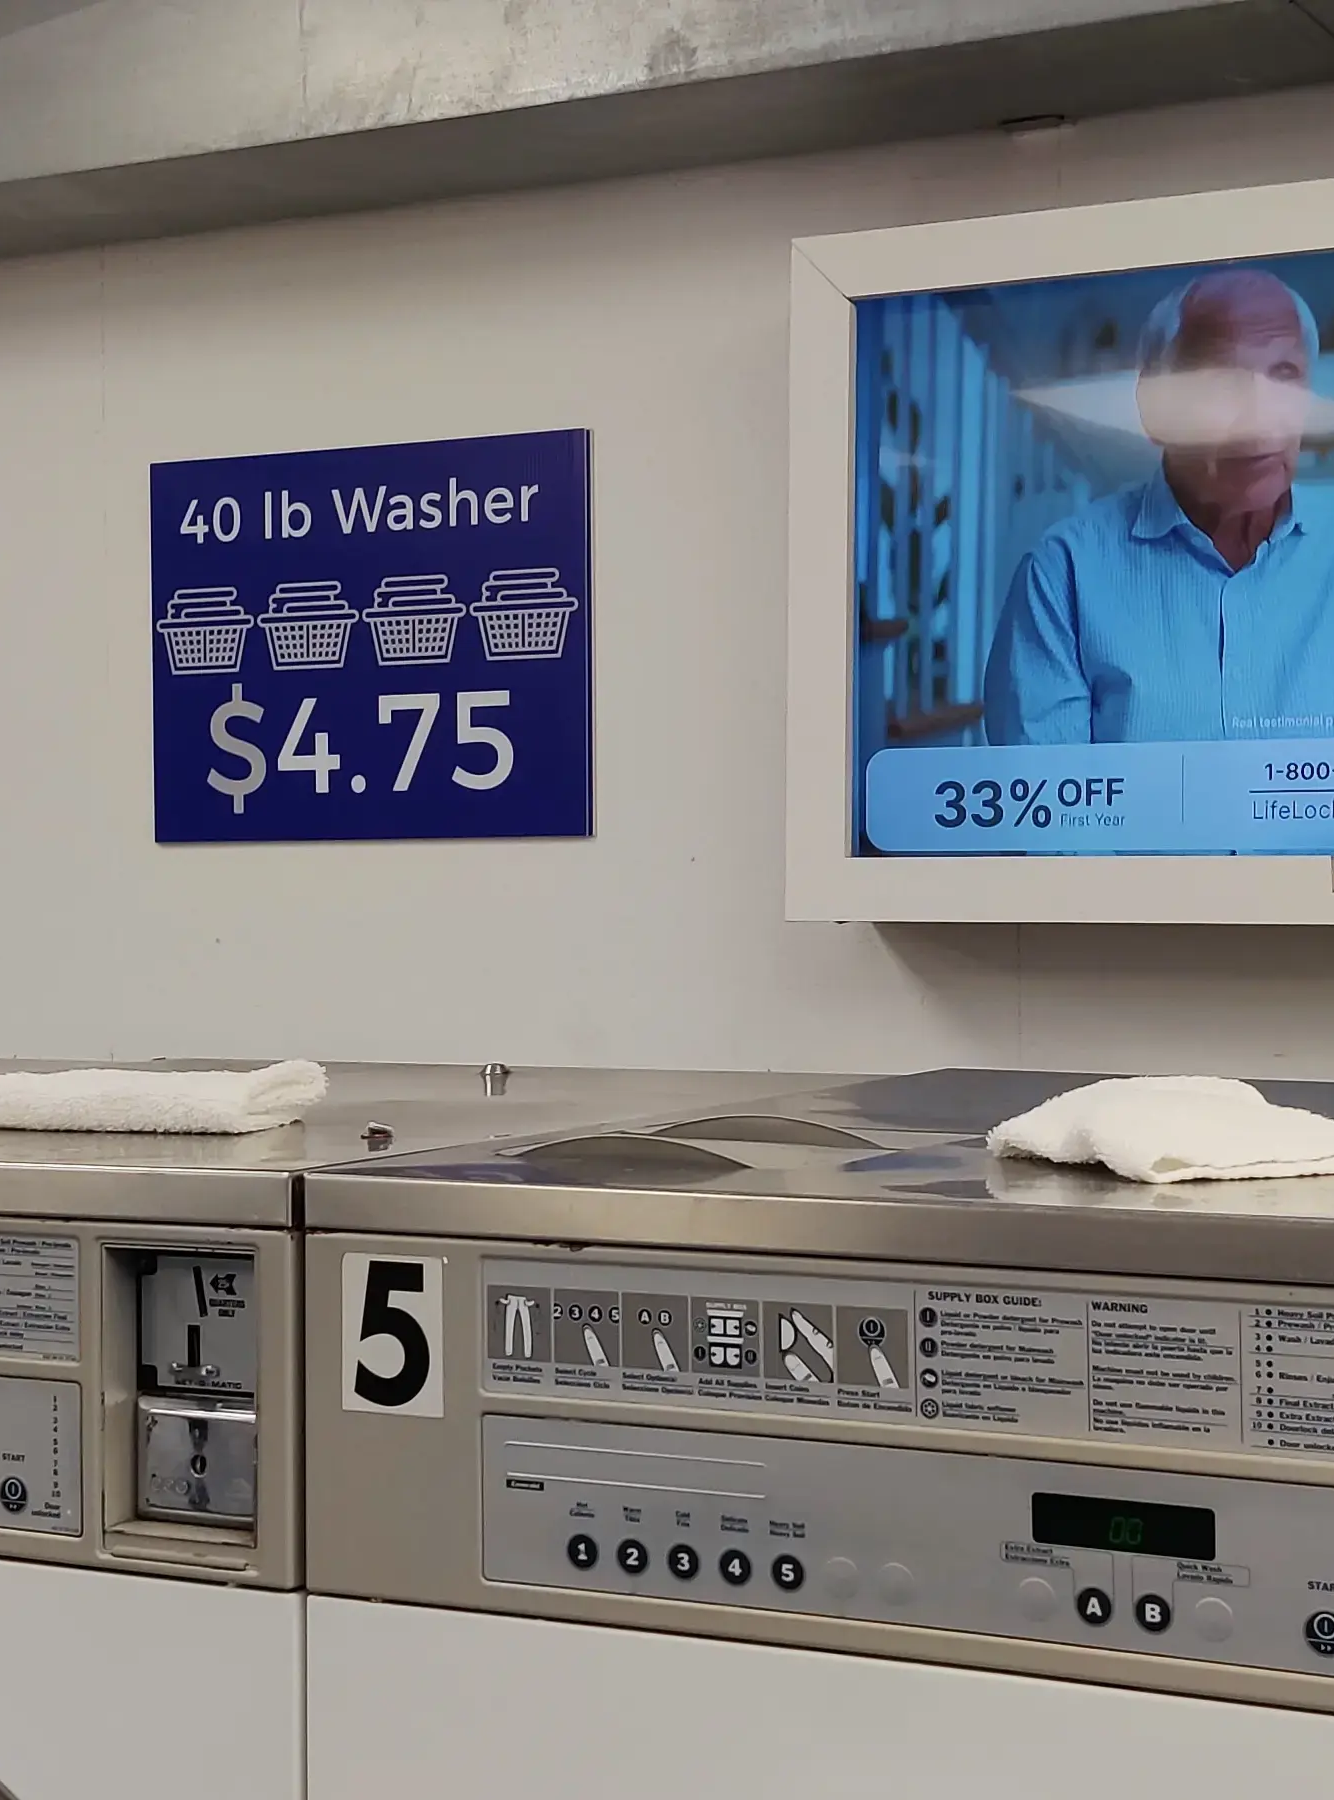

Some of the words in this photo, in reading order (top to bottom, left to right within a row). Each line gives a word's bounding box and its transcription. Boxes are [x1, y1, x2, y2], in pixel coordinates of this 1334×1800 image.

[180, 497, 241, 543] 40
[264, 490, 311, 539] lb
[332, 478, 539, 534] Washer
[1232, 717, 1256, 728] Real
[1259, 716, 1323, 727] testimonial
[207, 683, 514, 814] $4.75
[1057, 778, 1125, 807] OFF
[934, 778, 1052, 829] 33%
[1060, 813, 1090, 827] First
[1095, 813, 1125, 827] Year
[928, 1291, 971, 1302] SUPPLY
[976, 1293, 999, 1304] BOX
[1003, 1295, 1042, 1307] GUIDE:
[1092, 1301, 1148, 1313] WARNING
[571, 1307, 580, 1317] 3
[591, 1309, 600, 1319] 4
[641, 1312, 649, 1322] A
[661, 1313, 669, 1323] B
[354, 1261, 430, 1407] 5
[2, 1453, 25, 1462] START
[577, 1543, 587, 1560] 1
[626, 1548, 639, 1565] 2
[677, 1553, 690, 1570] 3
[728, 1558, 741, 1575] 4
[781, 1564, 794, 1581] 5
[1086, 1597, 1102, 1616] A
[1146, 1604, 1161, 1623] B
